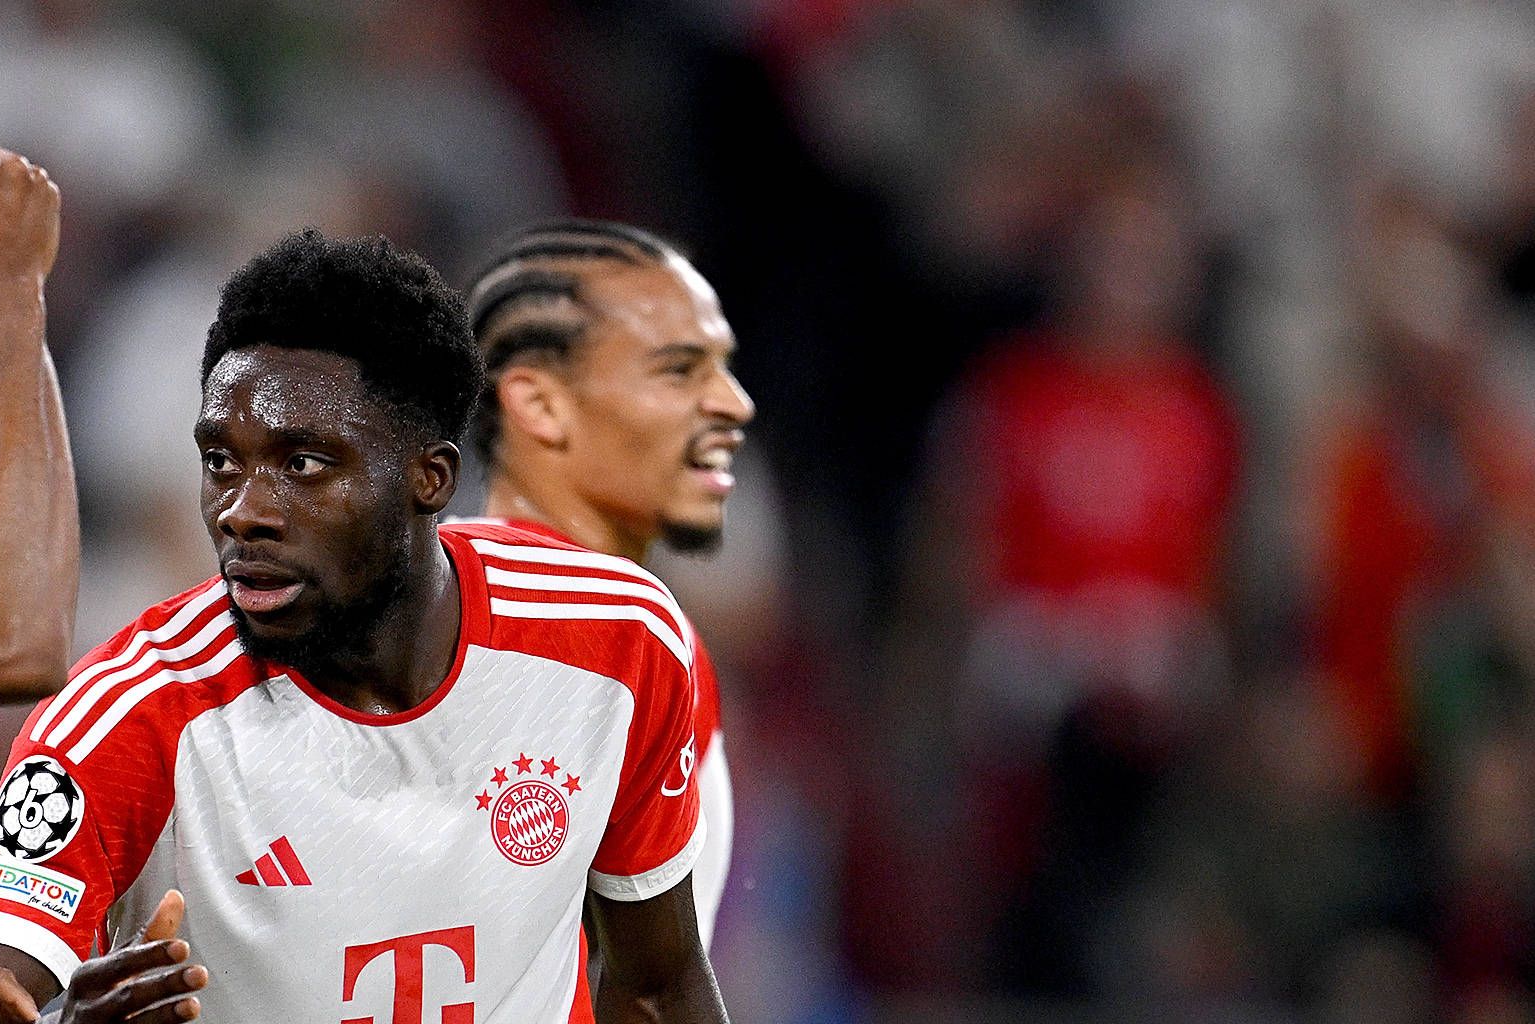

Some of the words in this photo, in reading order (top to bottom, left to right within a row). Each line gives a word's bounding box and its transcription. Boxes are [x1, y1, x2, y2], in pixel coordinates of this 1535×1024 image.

[19, 789, 44, 829] 6
[498, 801, 512, 821] FC
[510, 786, 563, 813] BAYERN
[501, 827, 564, 860] MÜNCHEN
[28, 896, 41, 904] for
[42, 901, 70, 918] children
